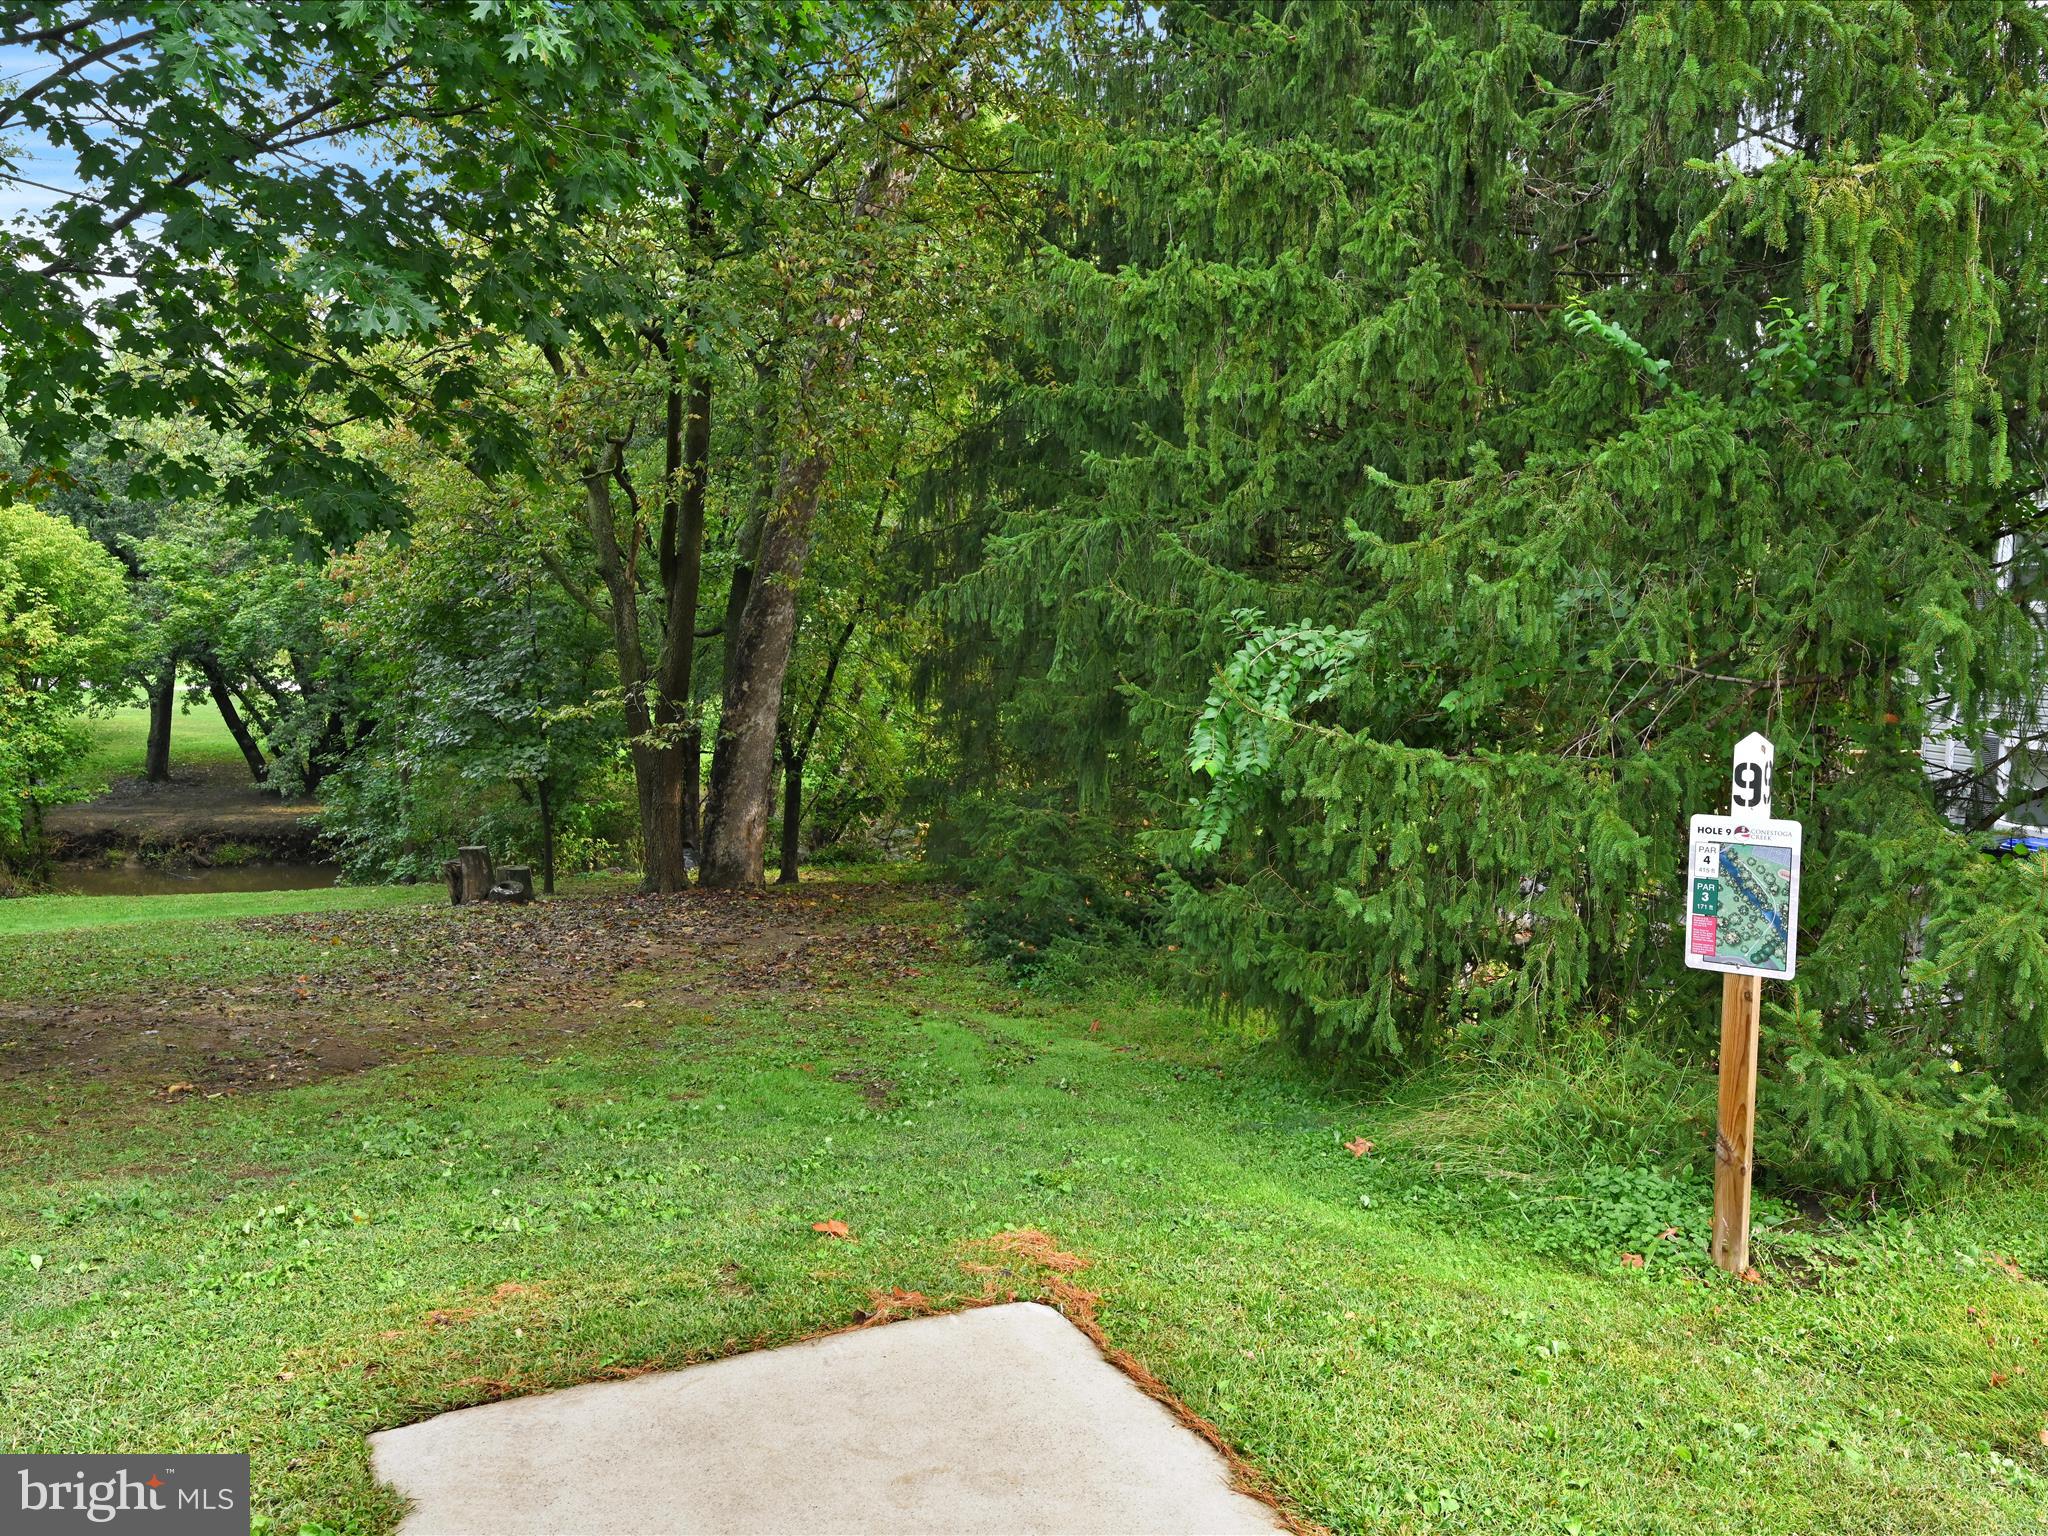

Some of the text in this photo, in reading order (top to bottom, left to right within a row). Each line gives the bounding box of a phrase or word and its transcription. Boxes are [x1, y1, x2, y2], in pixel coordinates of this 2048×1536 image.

[1733, 762, 1762, 808] 9
[1697, 826, 1732, 836] HOLE 9
[1750, 828, 1793, 838] CONESTOGA
[1698, 845, 1717, 854] PAR
[1703, 855, 1711, 865] 4
[1697, 883, 1715, 892] PAR
[1701, 892, 1709, 902] 3
